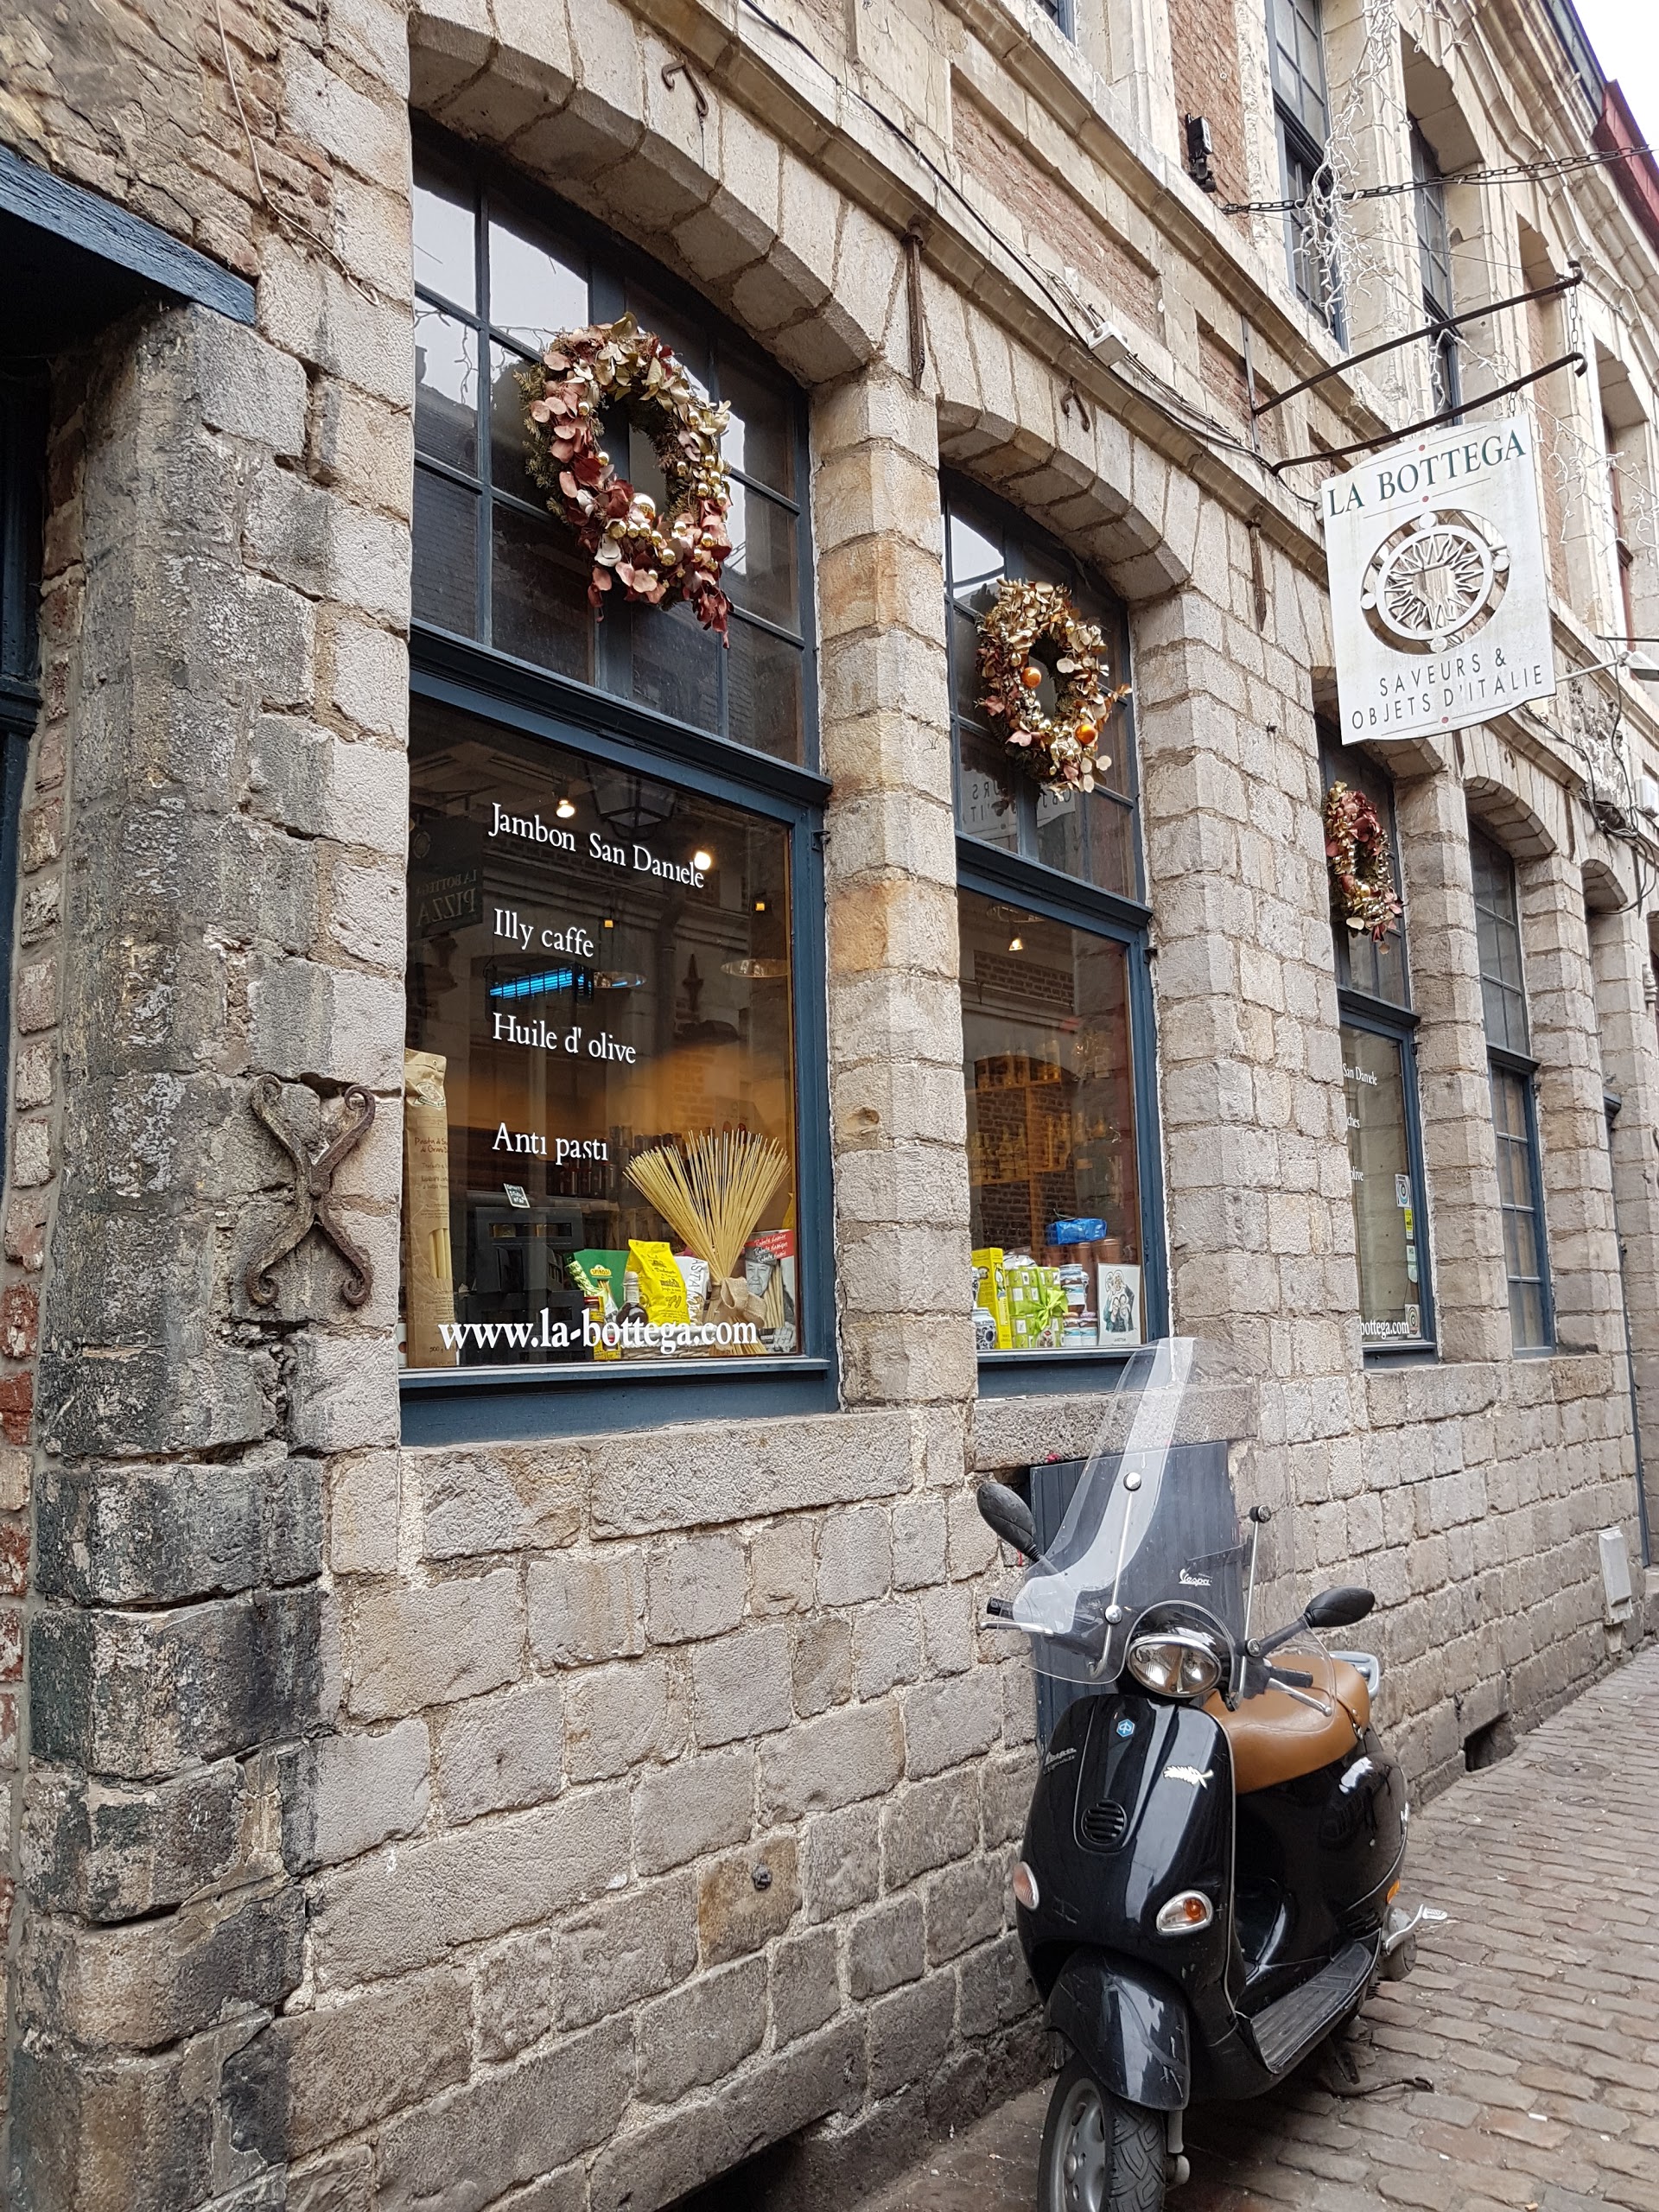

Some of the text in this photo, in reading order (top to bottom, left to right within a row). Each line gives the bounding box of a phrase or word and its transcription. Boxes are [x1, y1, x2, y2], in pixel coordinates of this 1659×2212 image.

[1327, 429, 1526, 517] LA BOTTEGA
[1380, 648, 1506, 696] SAVEURS &
[1351, 664, 1542, 729] OBJETS D'ITALIE
[488, 803, 576, 851] Jambon
[589, 832, 626, 867] San
[494, 908, 594, 957] Illy caffe
[493, 1012, 557, 1050] Huile
[588, 1032, 636, 1064] olive
[1343, 1063, 1354, 1078] San
[493, 1122, 607, 1166] Anti pasti
[689, 1258, 704, 1288] ASTA
[438, 1308, 758, 1355] www.la-bottega.com
[1361, 1319, 1410, 1339] bottega.com
[1179, 1568, 1211, 1586] Vespa
